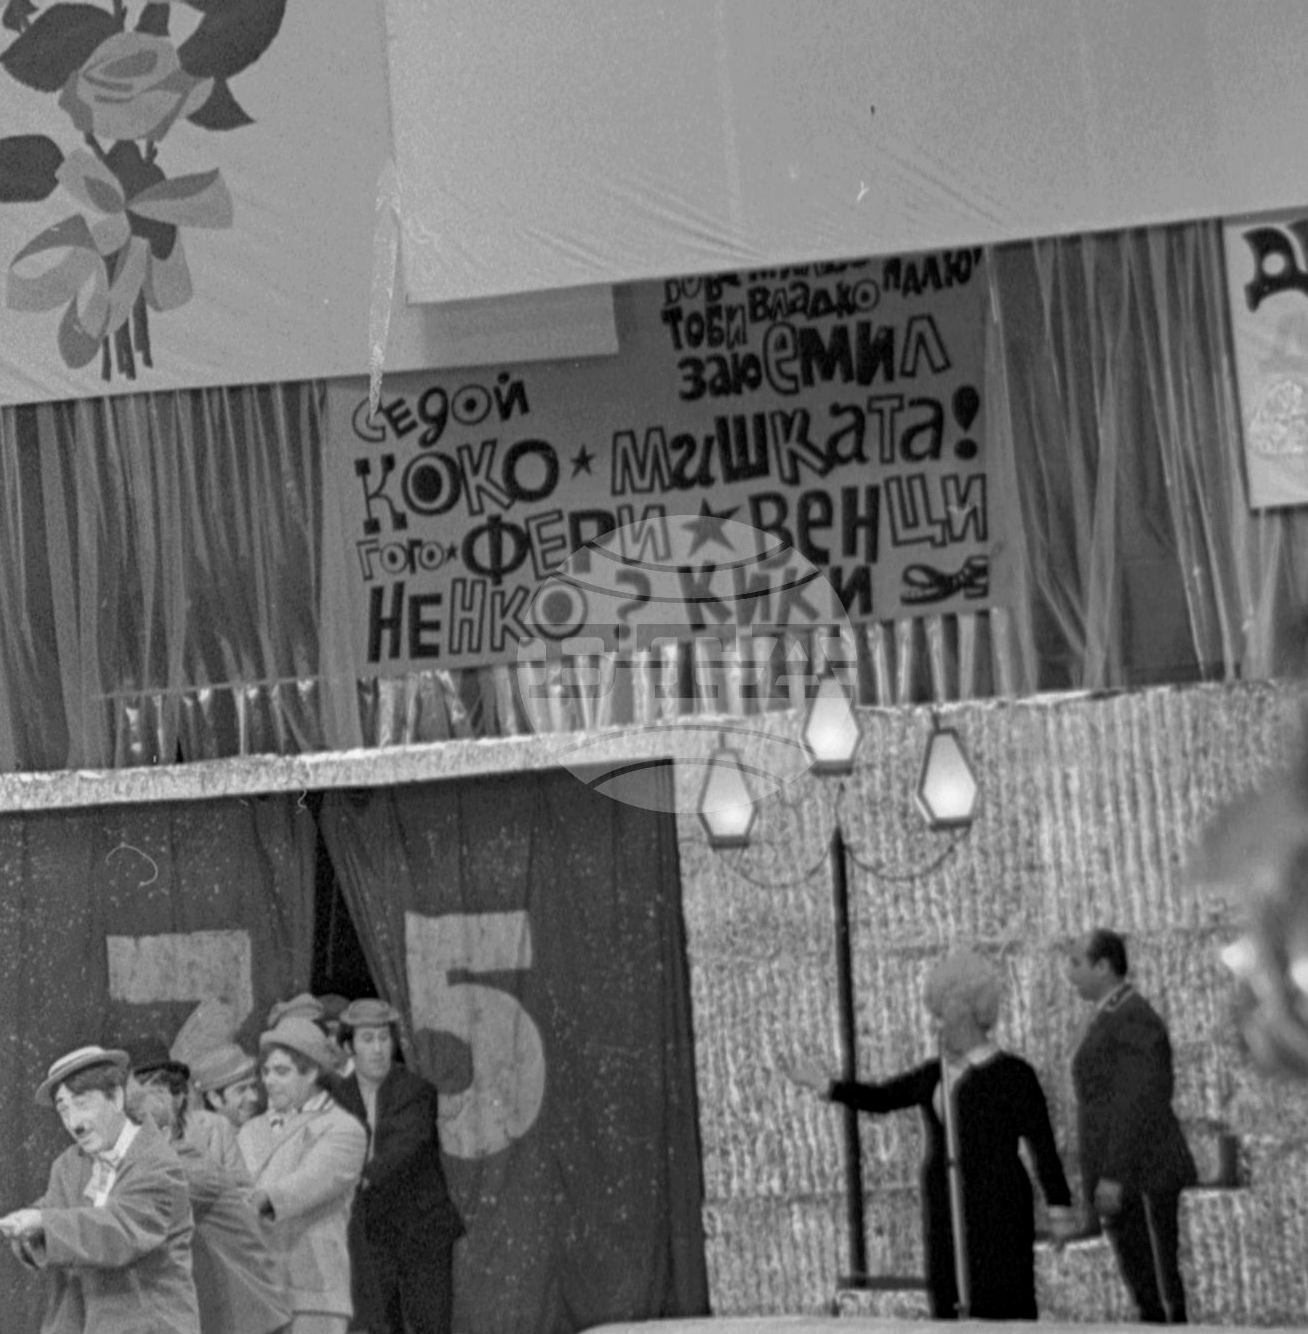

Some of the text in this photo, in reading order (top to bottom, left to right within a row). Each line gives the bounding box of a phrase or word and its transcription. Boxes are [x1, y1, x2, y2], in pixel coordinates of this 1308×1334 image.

[354, 438, 560, 536] КОКО
[461, 504, 672, 586] ФЕРИ
[367, 577, 589, 664] НЕНКО
